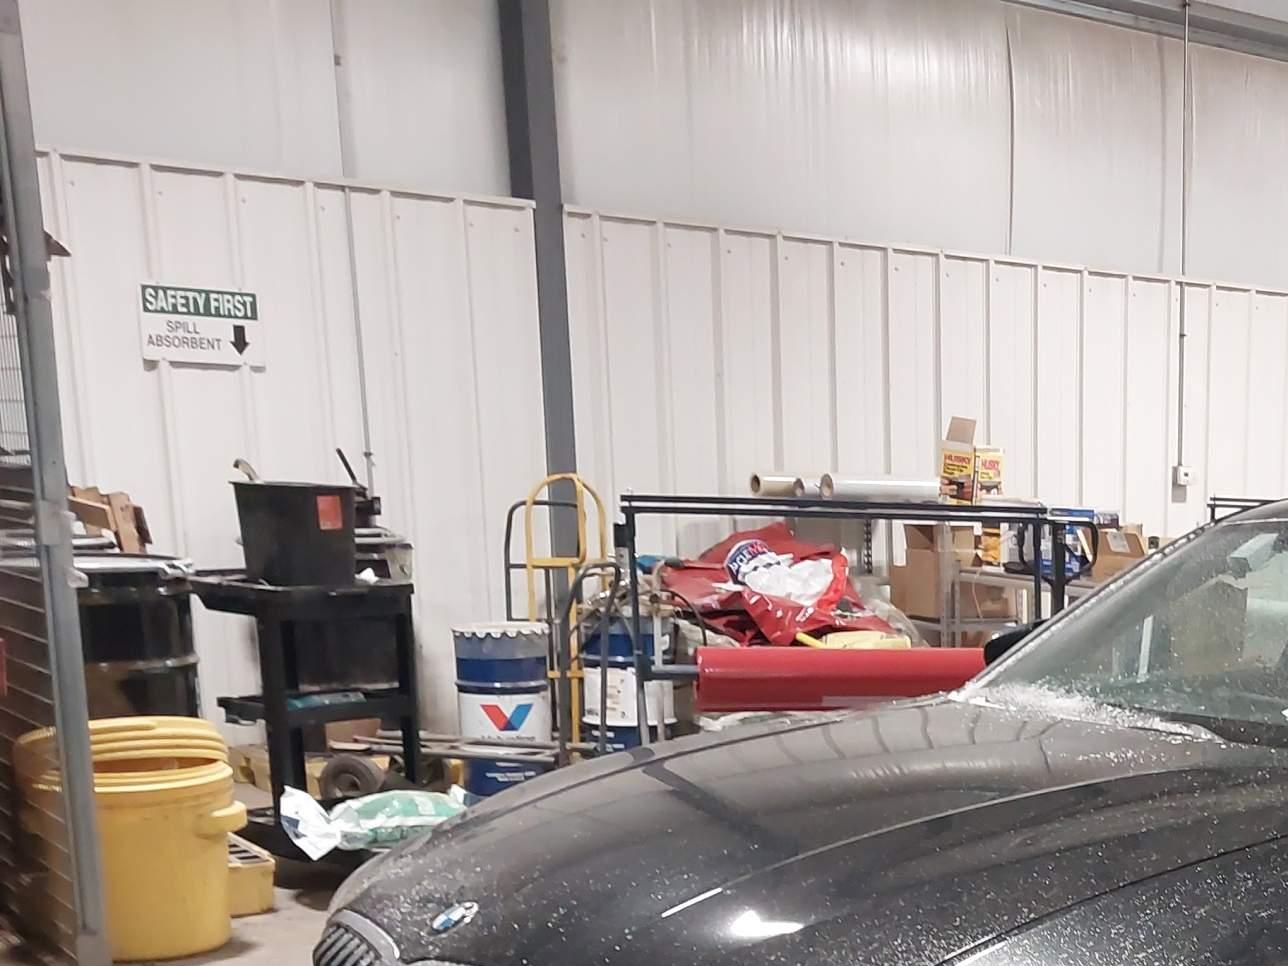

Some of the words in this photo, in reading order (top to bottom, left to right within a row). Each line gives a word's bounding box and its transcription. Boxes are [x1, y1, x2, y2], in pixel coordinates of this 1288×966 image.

[144, 287, 206, 314] SAFETY
[208, 292, 254, 318] FIRST
[166, 319, 201, 335] SPILL
[147, 333, 222, 351] ABSORBENT
